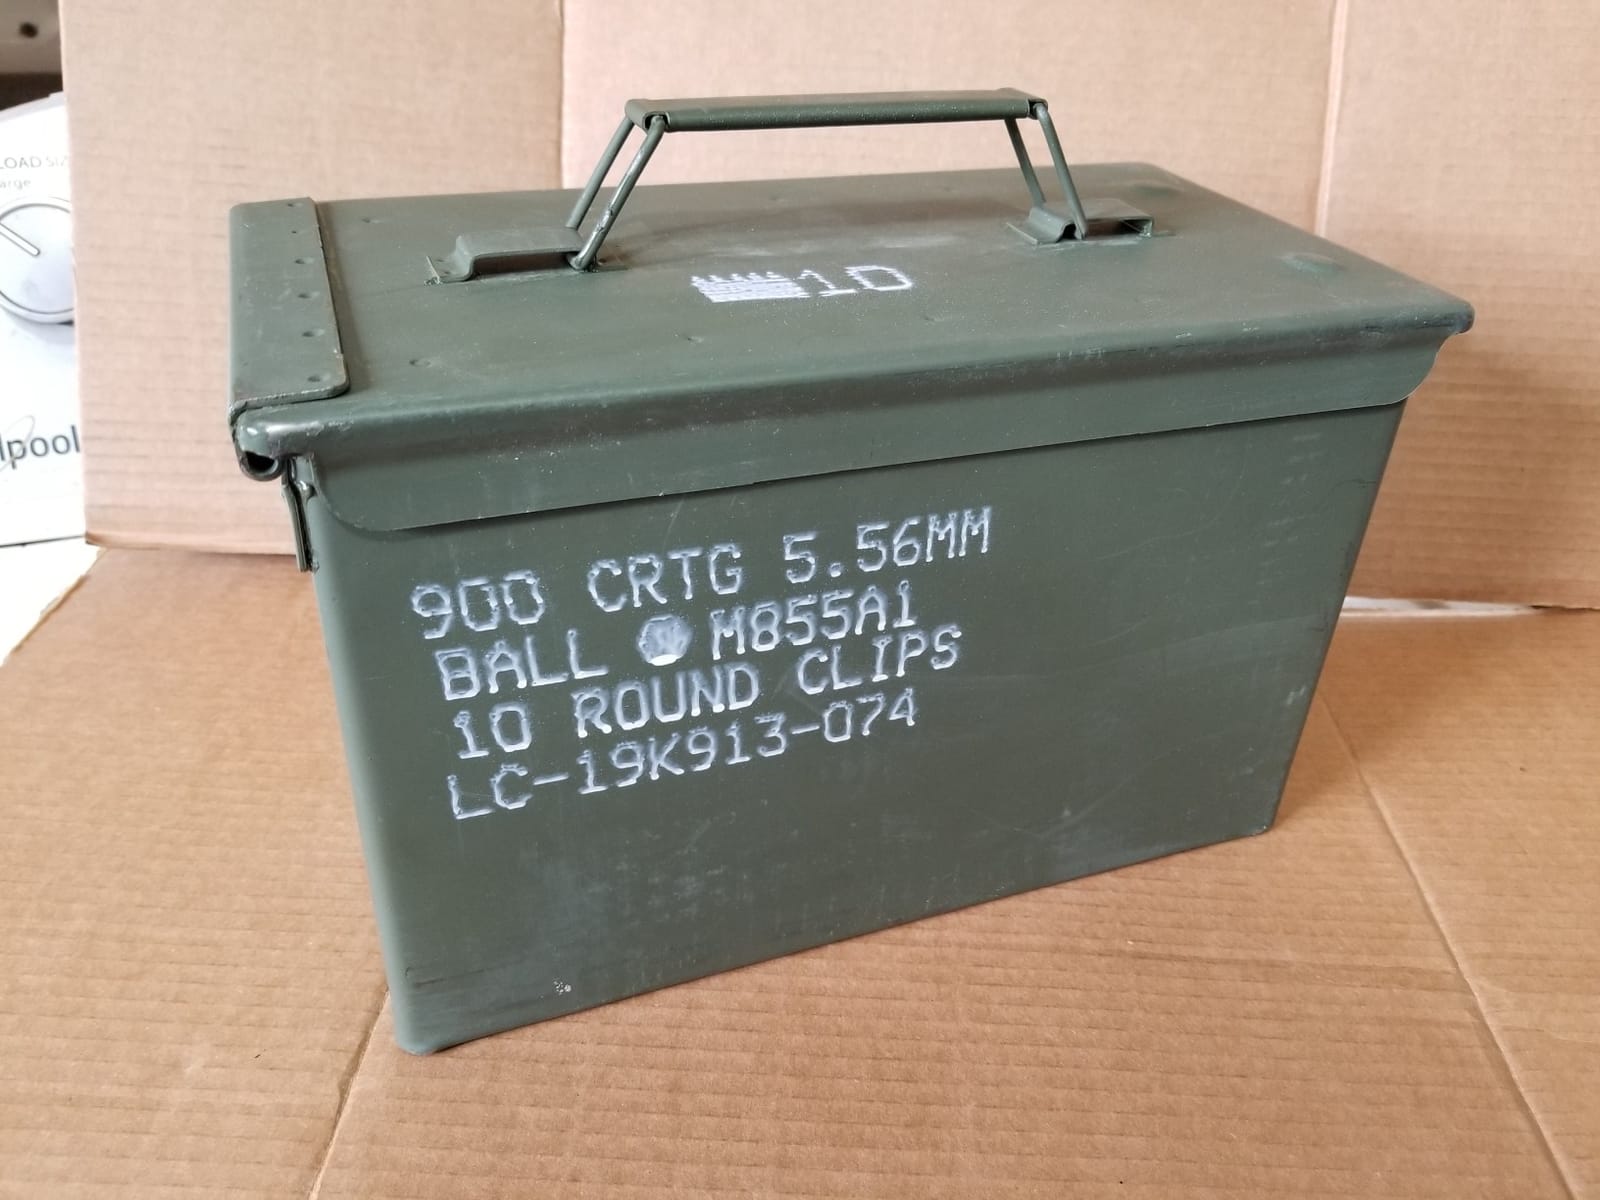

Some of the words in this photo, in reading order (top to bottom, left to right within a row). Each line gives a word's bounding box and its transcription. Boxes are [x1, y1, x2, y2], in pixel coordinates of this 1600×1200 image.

[411, 570, 545, 640] 900
[588, 543, 742, 613] CRTG
[783, 505, 991, 583] 5.56MM
[434, 628, 608, 701] BALL
[710, 579, 917, 661] M855A1
[454, 702, 532, 760] 10
[571, 662, 760, 738] ROUND
[797, 624, 962, 695] CLIPS
[447, 687, 917, 820] LC-19K913-074
